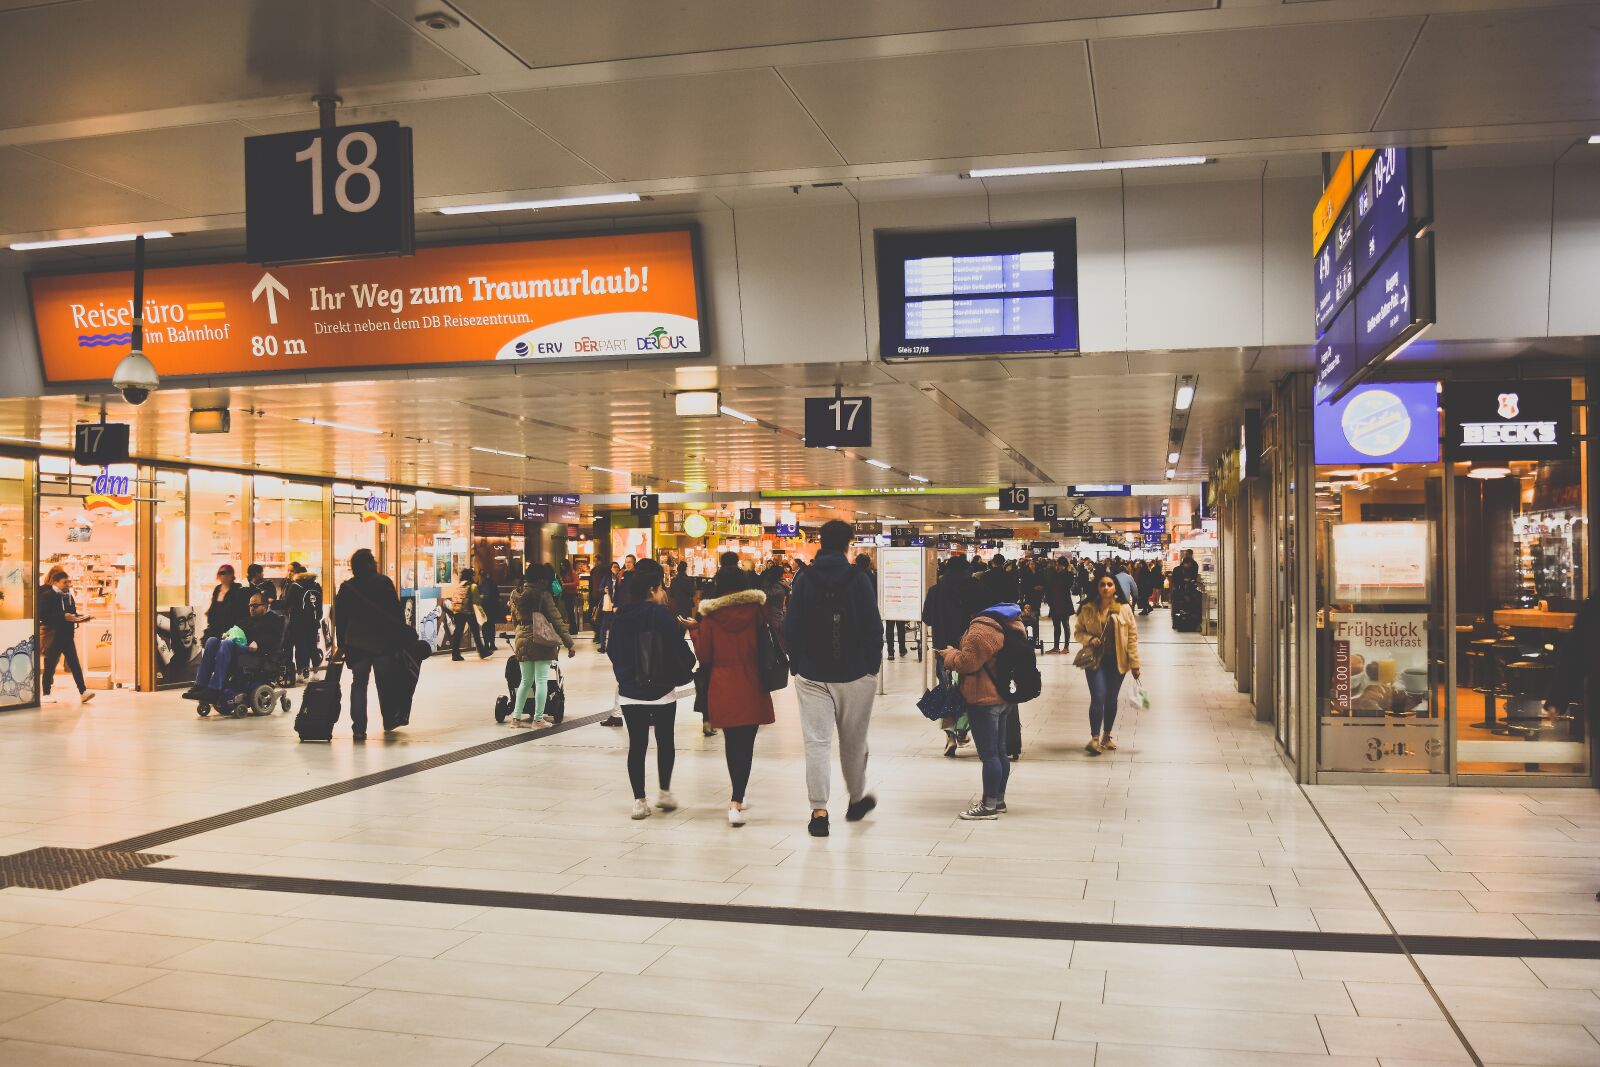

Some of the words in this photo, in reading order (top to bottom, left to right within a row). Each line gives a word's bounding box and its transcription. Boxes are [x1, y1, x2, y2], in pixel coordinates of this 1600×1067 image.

[296, 131, 381, 215] 18
[309, 286, 346, 311] Ihr
[350, 283, 404, 314] Weg
[410, 284, 464, 305] zum
[468, 266, 649, 302] Traumurlaub!
[145, 328, 163, 345] im
[167, 323, 231, 344] Bahnhof
[314, 321, 351, 335] Direkt
[353, 318, 391, 333] neben
[393, 317, 420, 330] dem
[423, 315, 441, 328] DB
[443, 312, 534, 327] Reisezentrum.
[251, 335, 278, 357] 80
[283, 338, 307, 355] m
[538, 342, 563, 354] ERV
[828, 399, 862, 431] 17
[80, 426, 104, 453] 17
[1463, 421, 1557, 443] BECK'S
[95, 465, 129, 495] dm
[632, 495, 649, 509] 16
[1009, 489, 1026, 504] 16
[741, 508, 753, 520] 15
[1041, 505, 1055, 517] 15
[1337, 621, 1418, 637] Frühstück
[1336, 643, 1348, 662] Uhr
[1364, 637, 1422, 648] Breakfast
[1336, 666, 1348, 691] 8.00
[1337, 694, 1348, 707] ab
